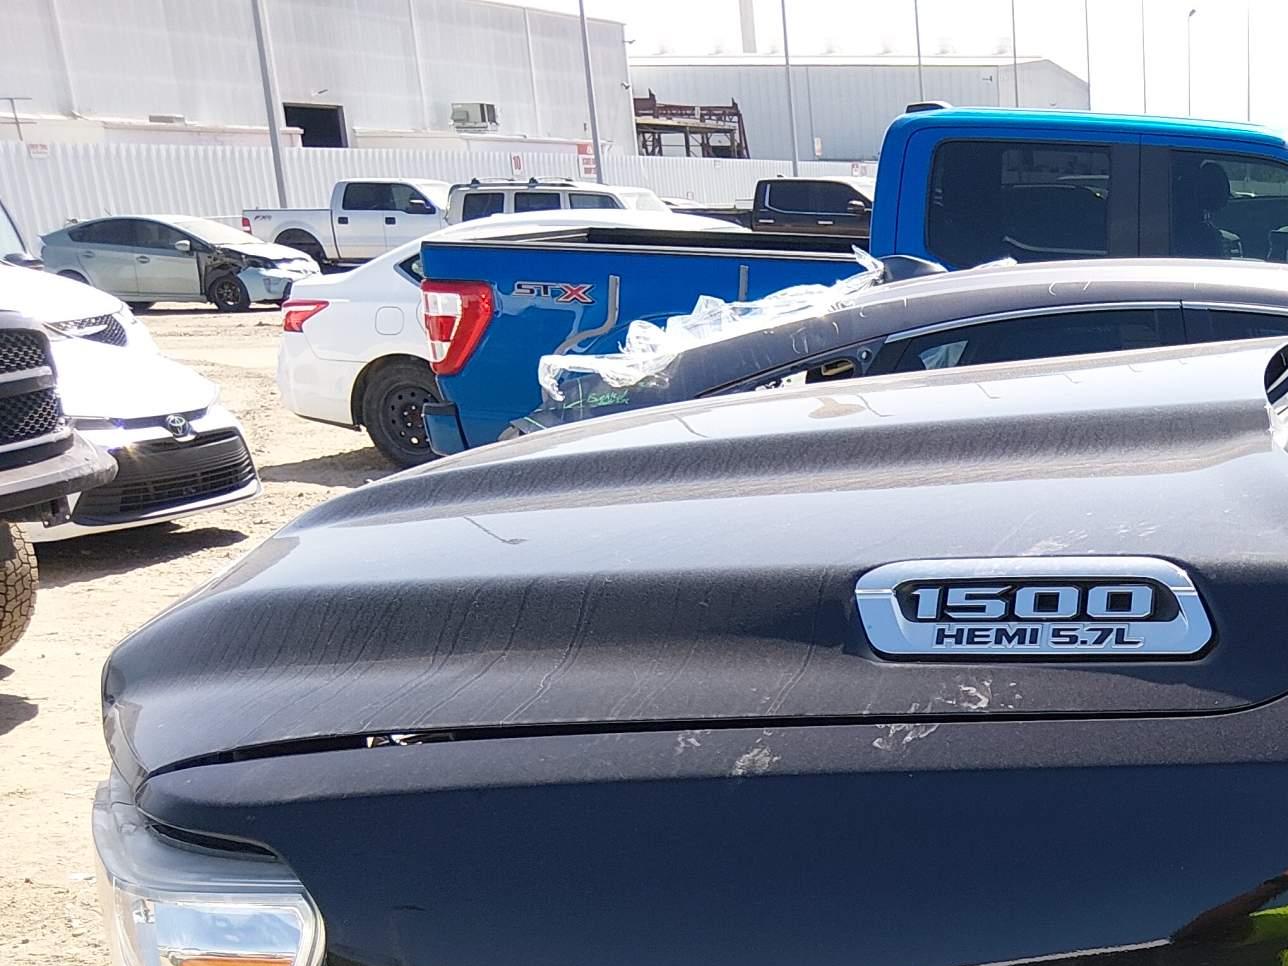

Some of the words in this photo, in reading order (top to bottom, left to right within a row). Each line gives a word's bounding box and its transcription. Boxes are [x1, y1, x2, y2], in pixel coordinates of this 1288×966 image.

[512, 281, 596, 305] STX
[911, 584, 1155, 620] 1500
[934, 625, 1044, 647] HEMI
[1049, 625, 1145, 647] 5.7L
